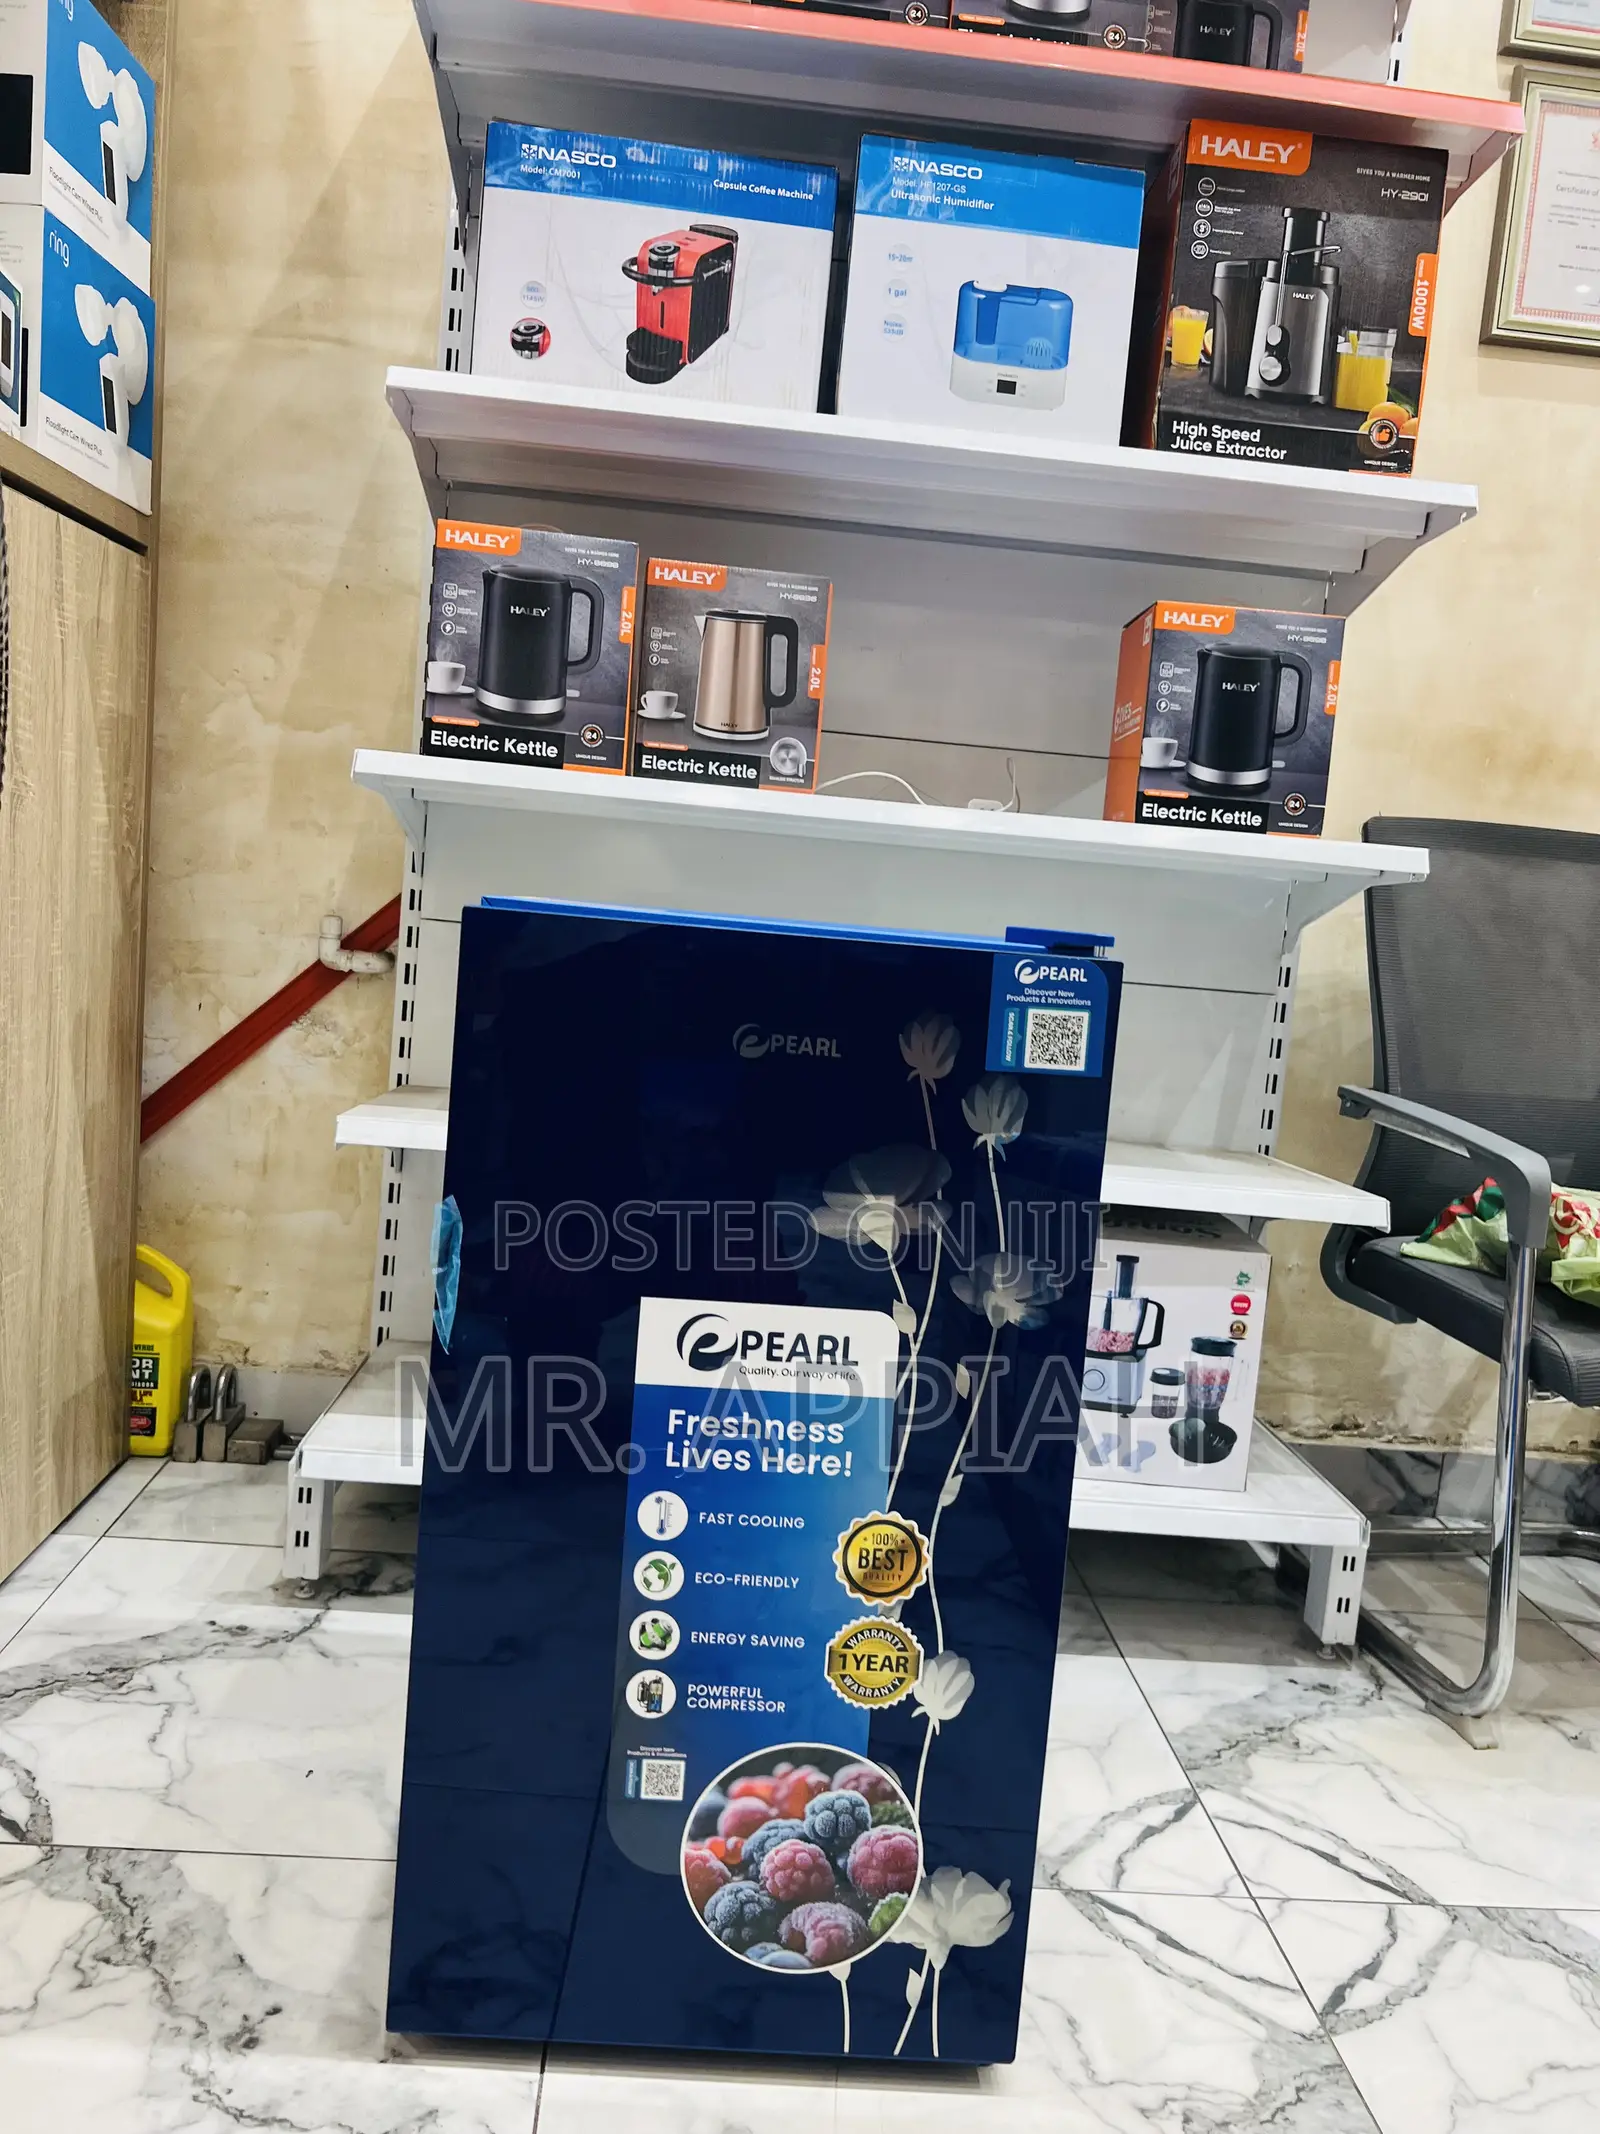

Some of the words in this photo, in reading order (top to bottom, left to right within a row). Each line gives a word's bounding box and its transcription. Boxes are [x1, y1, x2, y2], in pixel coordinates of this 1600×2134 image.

[911, 8, 921, 18] 24
[1109, 31, 1120, 41] 24
[1199, 24, 1233, 36] HALEY
[538, 145, 617, 169] NASCO
[1200, 134, 1295, 164] HALEY
[520, 163, 548, 174] Model:
[548, 167, 580, 179] CM7001
[909, 159, 983, 180] NASCO
[713, 178, 747, 191] Capsule
[748, 184, 776, 195] Coffee
[777, 188, 814, 200] Machine
[1380, 187, 1429, 202] HY-2901
[1556, 184, 1590, 196] Certificate
[891, 188, 941, 204] Ultrasonic
[943, 195, 995, 211] Humidifier
[49, 228, 71, 268] ring
[1292, 291, 1315, 300] HALEY
[1411, 279, 1431, 330] 1000W
[1172, 420, 1208, 439] High
[1211, 424, 1261, 443] Speed
[1170, 436, 1213, 452] Juice
[1216, 439, 1288, 460] Extractor
[445, 528, 511, 549] HALEY
[655, 566, 717, 586] HALEY
[510, 605, 548, 617] HALEY
[1163, 610, 1225, 628] HALEY
[620, 610, 632, 637] 2.0L
[809, 667, 822, 692] 2.0L
[1222, 681, 1258, 692] HALEY
[1326, 683, 1338, 709] 2.0L
[430, 730, 499, 752] Electric
[504, 737, 559, 758] Kettle
[586, 731, 598, 740] 24
[641, 754, 705, 774] Electric
[707, 761, 758, 780] Kettle
[1289, 800, 1300, 808] 24
[1141, 802, 1207, 823] Electric
[1210, 809, 1263, 827] Kettle
[1039, 965, 1088, 982] PEARL
[1006, 993, 1040, 1003] Products
[1047, 997, 1092, 1006] Innovations
[1024, 987, 1057, 997] Discover
[1057, 989, 1075, 998] New
[770, 1032, 842, 1058] PEARL
[740, 1329, 860, 1367] PEARL
[738, 1366, 779, 1378] Quality.
[781, 1367, 801, 1377] Our
[802, 1370, 824, 1381] way
[827, 1370, 838, 1380] of
[840, 1371, 859, 1381] life.
[668, 1408, 845, 1444] Freshness
[665, 1440, 752, 1471] Lives
[761, 1446, 853, 1477] Here!
[699, 1511, 735, 1526] FAST
[738, 1514, 805, 1529] COOLING
[871, 1532, 899, 1547] 100%
[858, 1546, 909, 1572] BEST
[694, 1571, 800, 1589] ECO-FRIENDLY
[862, 1571, 903, 1582] QUALITY
[690, 1631, 747, 1646] ENERGY
[750, 1634, 806, 1649] SAVING
[846, 1629, 905, 1651] WARRANTY
[838, 1653, 847, 1670] 1
[852, 1653, 910, 1674] YEAR
[687, 1684, 764, 1699] POWERFUL
[843, 1675, 901, 1698] WARRANTY
[686, 1697, 786, 1713] COMPRESSOR
